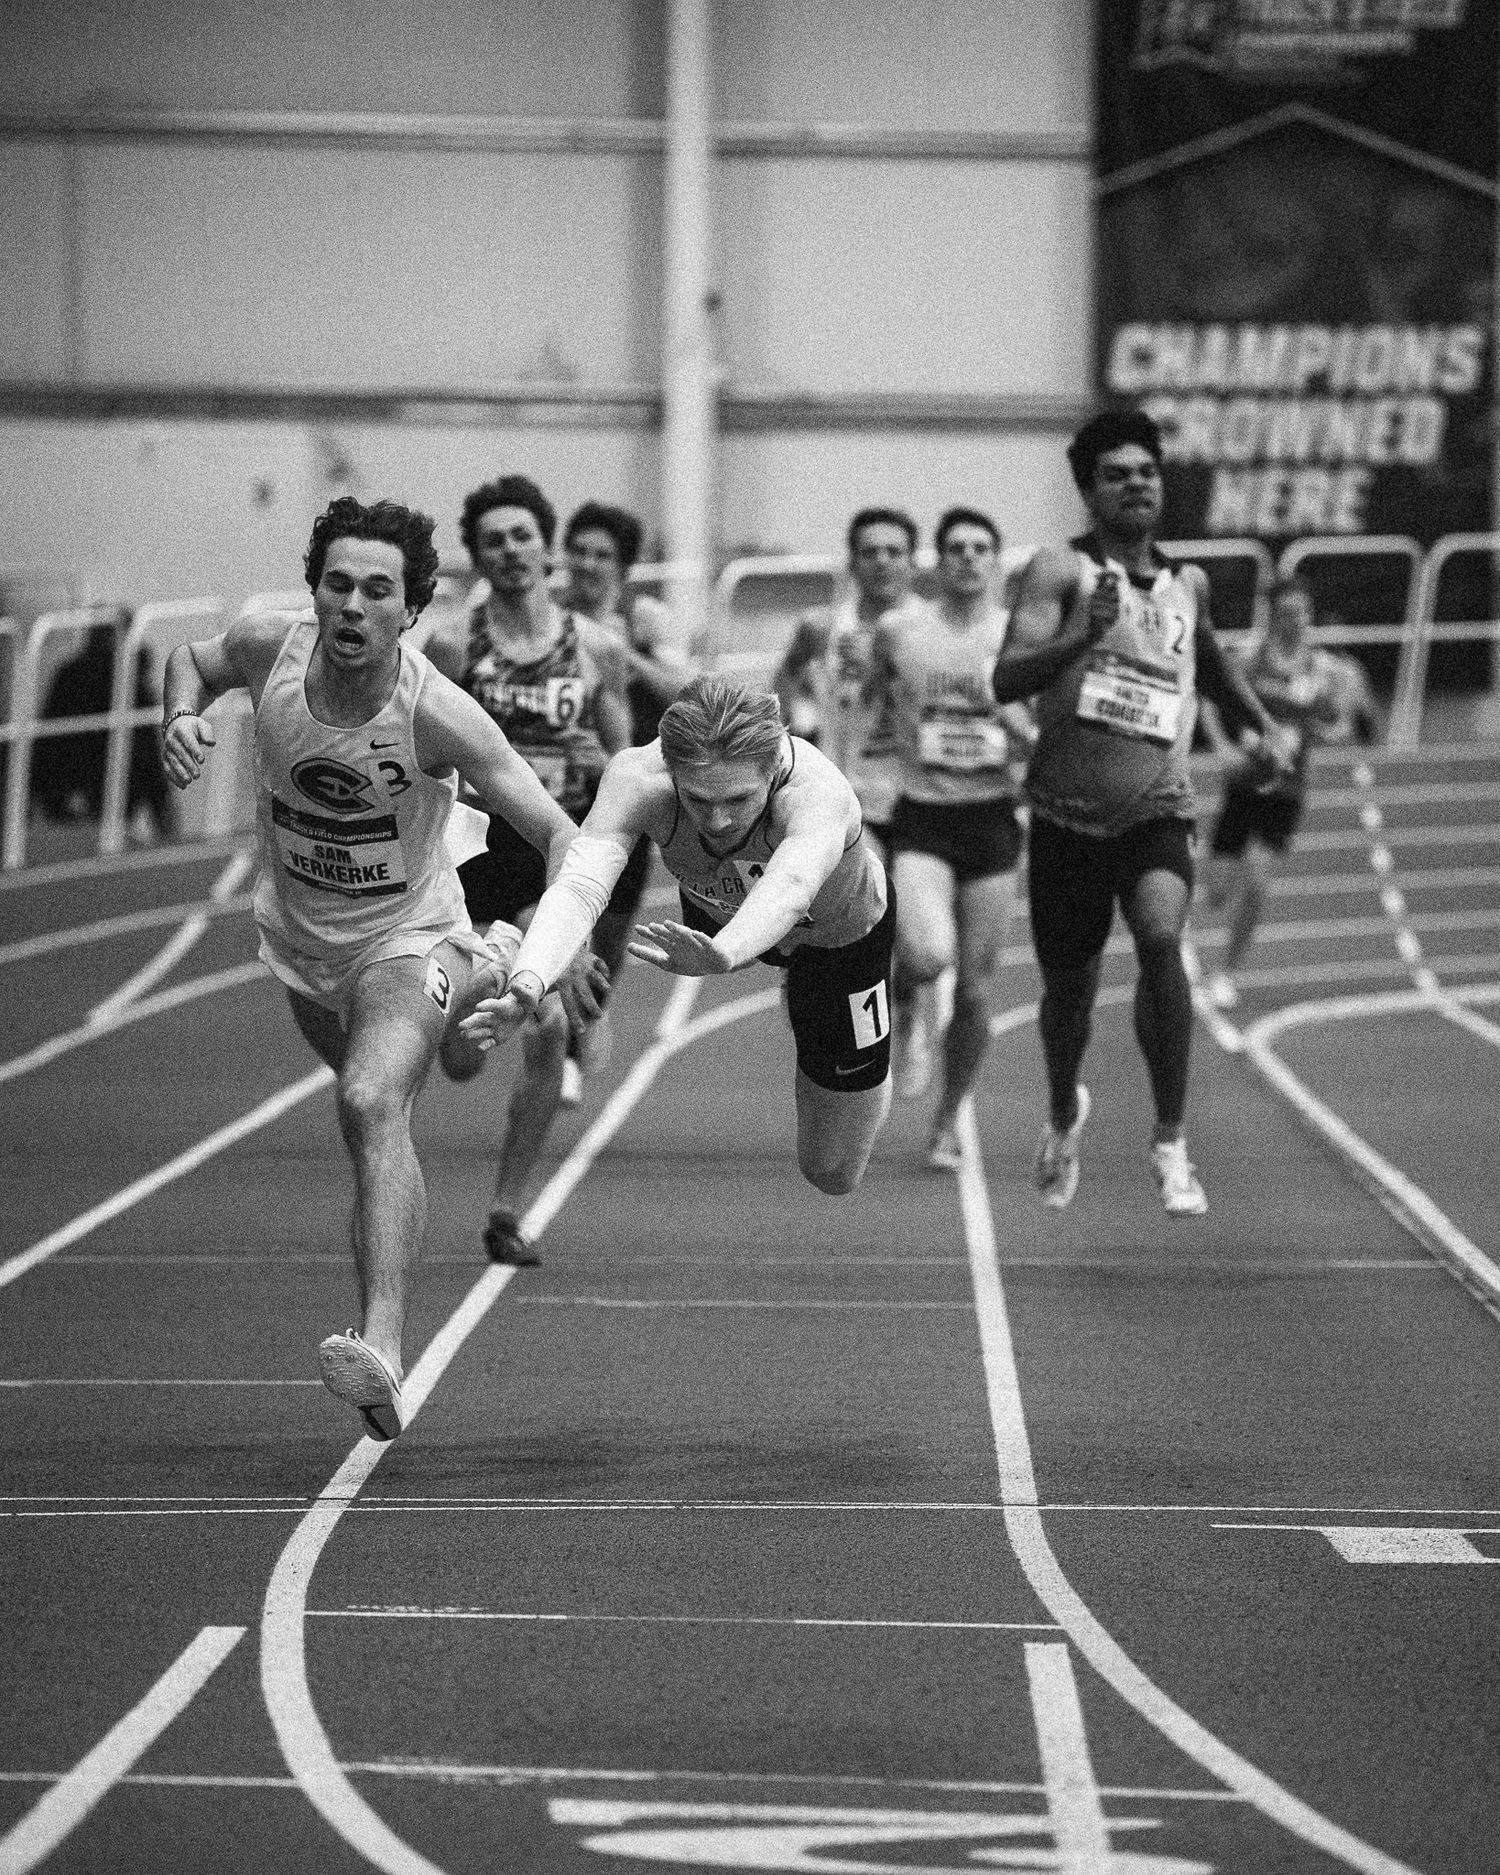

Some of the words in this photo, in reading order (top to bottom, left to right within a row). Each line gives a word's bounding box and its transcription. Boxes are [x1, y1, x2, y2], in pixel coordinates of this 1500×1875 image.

[1109, 323, 1482, 392] CHAMPIONS
[1208, 469, 1371, 533] HERE
[1170, 614, 1187, 655] 2
[556, 682, 576, 722] 6
[377, 759, 413, 798] 3
[314, 830, 332, 839] FIELD
[333, 830, 392, 842] CHAMPIONSHIPS
[314, 844, 352, 864] SAM
[288, 849, 390, 884] VERKERKE
[431, 966, 450, 1010] 3
[862, 989, 882, 1039] 1
